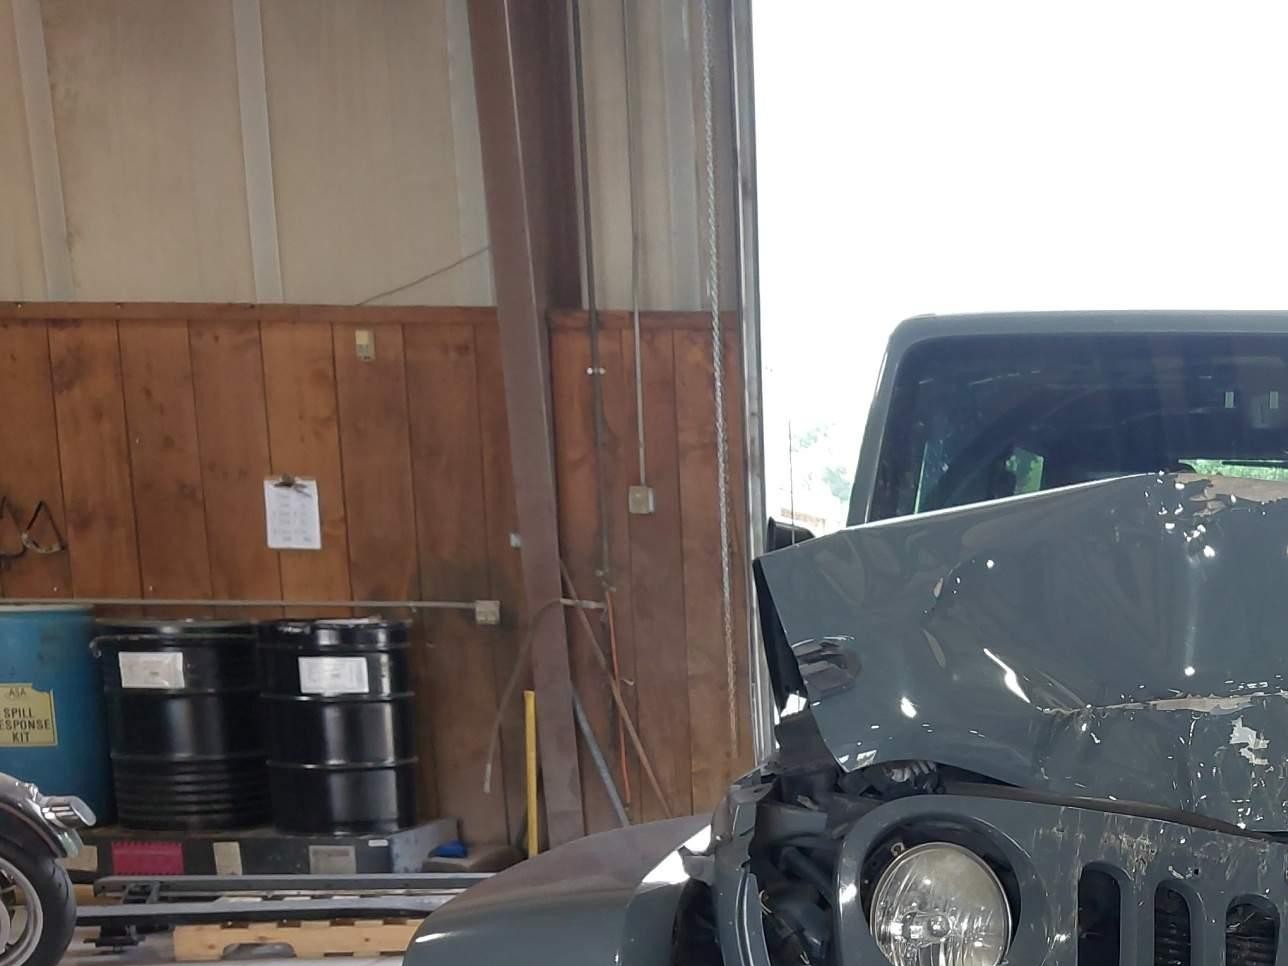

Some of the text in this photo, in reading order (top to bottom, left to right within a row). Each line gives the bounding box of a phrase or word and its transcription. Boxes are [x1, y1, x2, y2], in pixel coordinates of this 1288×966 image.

[3, 707, 33, 719] SPILL
[0, 719, 50, 730] ESPONSE
[12, 731, 30, 743] KIT
